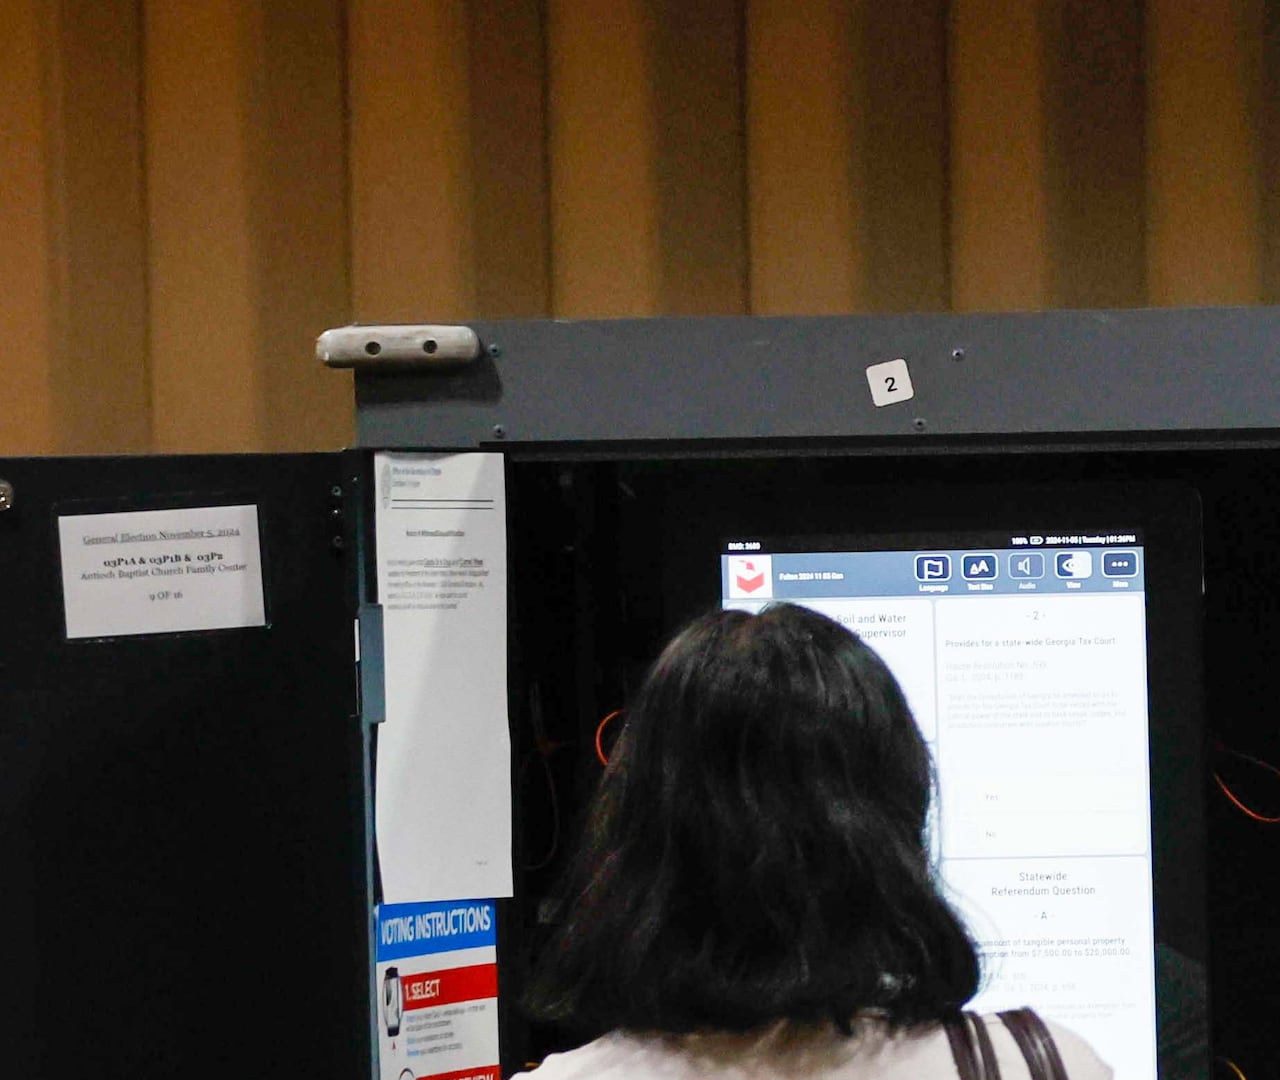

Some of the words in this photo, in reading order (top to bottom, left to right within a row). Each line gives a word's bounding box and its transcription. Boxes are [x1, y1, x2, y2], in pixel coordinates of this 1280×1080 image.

[884, 377, 898, 392] 2
[83, 534, 118, 545] General
[121, 533, 158, 544] Election
[159, 530, 203, 541] November
[81, 569, 115, 580] Antioch
[119, 568, 149, 580] Baptist
[151, 567, 184, 576] Church
[186, 565, 215, 576] Family
[218, 562, 248, 571] Center
[919, 583, 948, 592] Language
[1018, 582, 1036, 590] Audio
[1065, 581, 1081, 590] View
[1112, 580, 1128, 589] More
[157, 591, 170, 600] OF
[837, 614, 855, 624] Soil
[858, 613, 875, 624] and
[878, 612, 906, 623] Water
[855, 628, 906, 639] Supervisor
[945, 640, 979, 649] Provides
[981, 640, 992, 648] for
[1045, 637, 1075, 648] Georgia
[1019, 871, 1067, 881] Statewide
[991, 885, 1049, 897] Referendum
[1052, 885, 1095, 897] Question
[381, 916, 414, 945] VOTING
[415, 905, 490, 940] INSTRUCTIONS
[1023, 936, 1054, 948] tangible
[1057, 936, 1090, 947] personal
[1092, 935, 1125, 947] property
[1010, 949, 1030, 958] from
[411, 979, 440, 1000] SELECT
